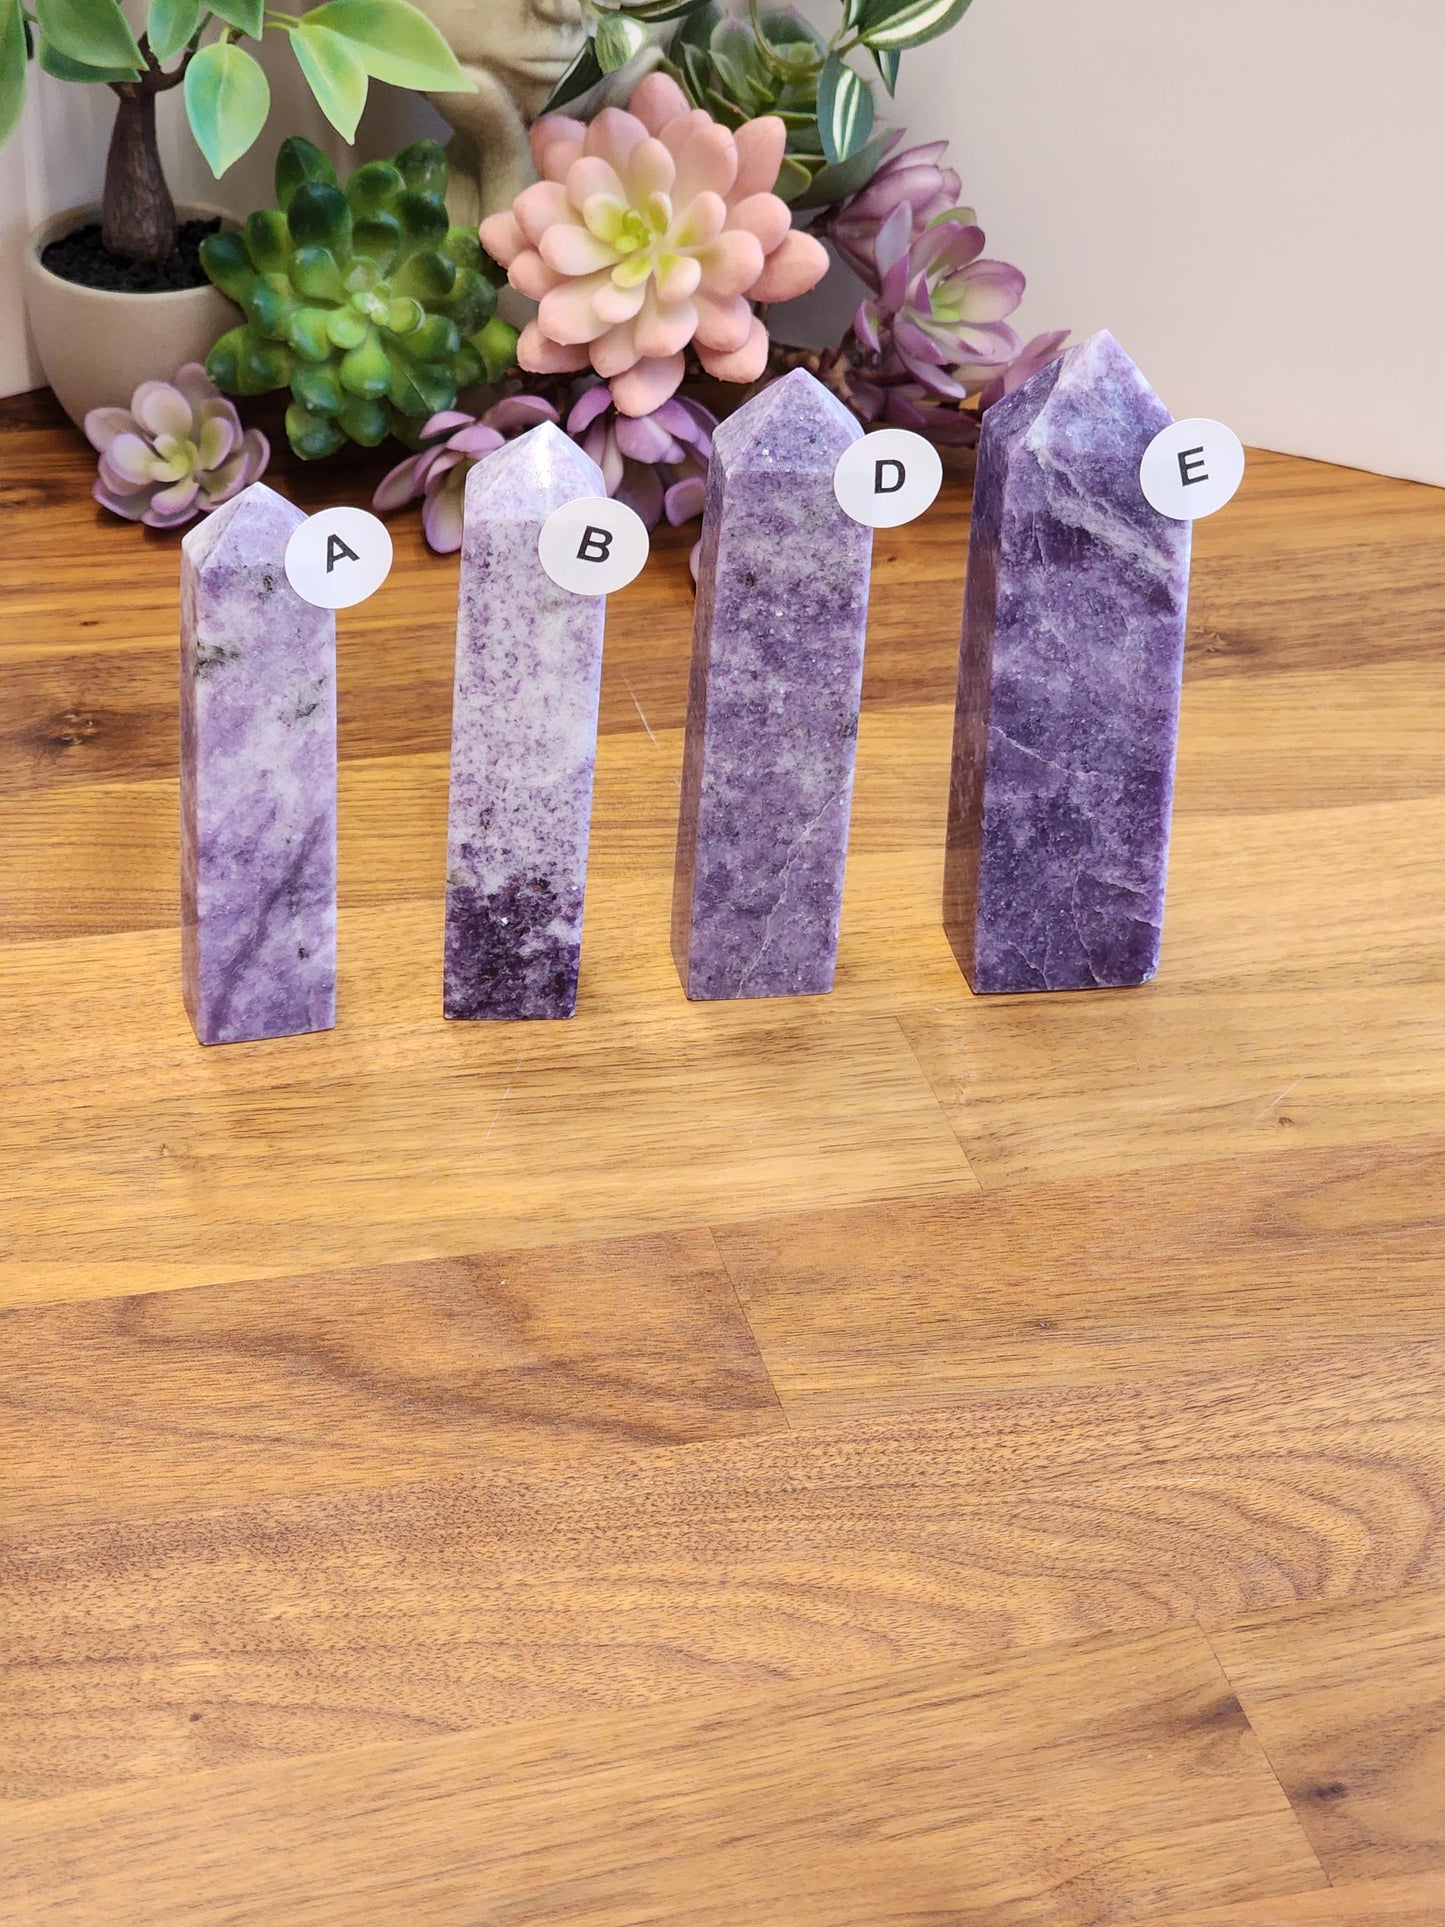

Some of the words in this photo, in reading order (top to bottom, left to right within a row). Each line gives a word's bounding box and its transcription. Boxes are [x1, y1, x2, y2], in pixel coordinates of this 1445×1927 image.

[874, 459, 906, 495] D
[1177, 446, 1209, 487] E
[326, 533, 361, 574] A
[576, 525, 613, 563] B
